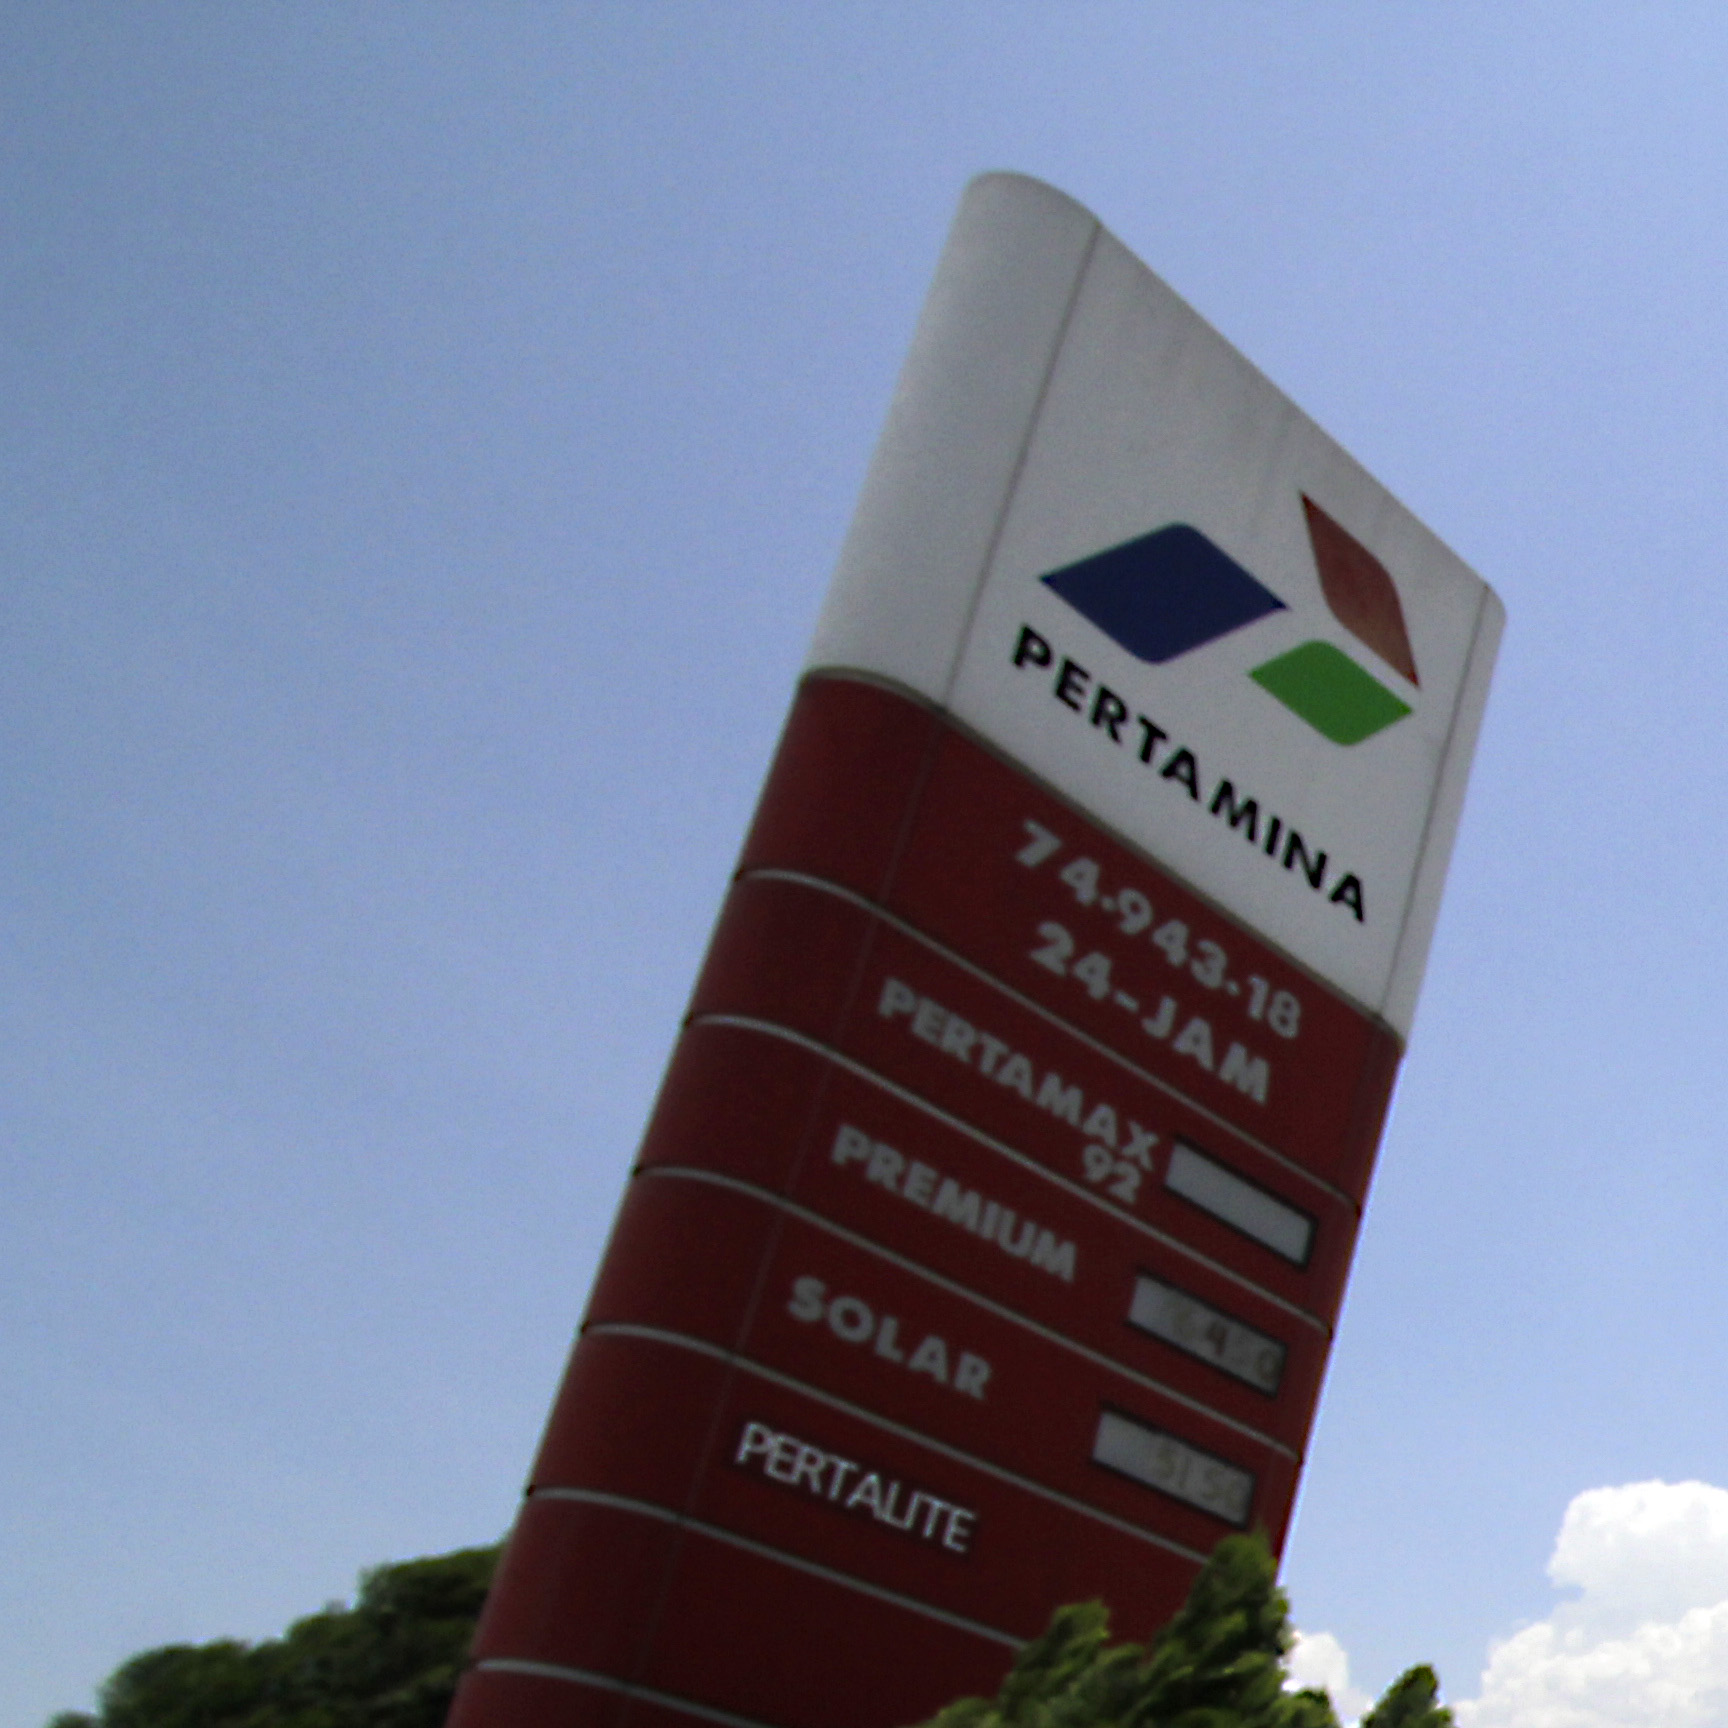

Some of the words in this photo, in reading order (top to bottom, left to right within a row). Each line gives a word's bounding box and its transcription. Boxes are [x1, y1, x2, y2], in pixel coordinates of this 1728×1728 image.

[1011, 622, 1367, 925] PERTAMINA
[878, 976, 1160, 1171] PERTAMAX
[1029, 921, 1270, 1105] 24-JAM
[831, 1123, 1078, 1282] PREMIUM
[1081, 1143, 1142, 1204] 92
[787, 1276, 992, 1401] SOLAR
[734, 1420, 979, 1553] PERTALITE
